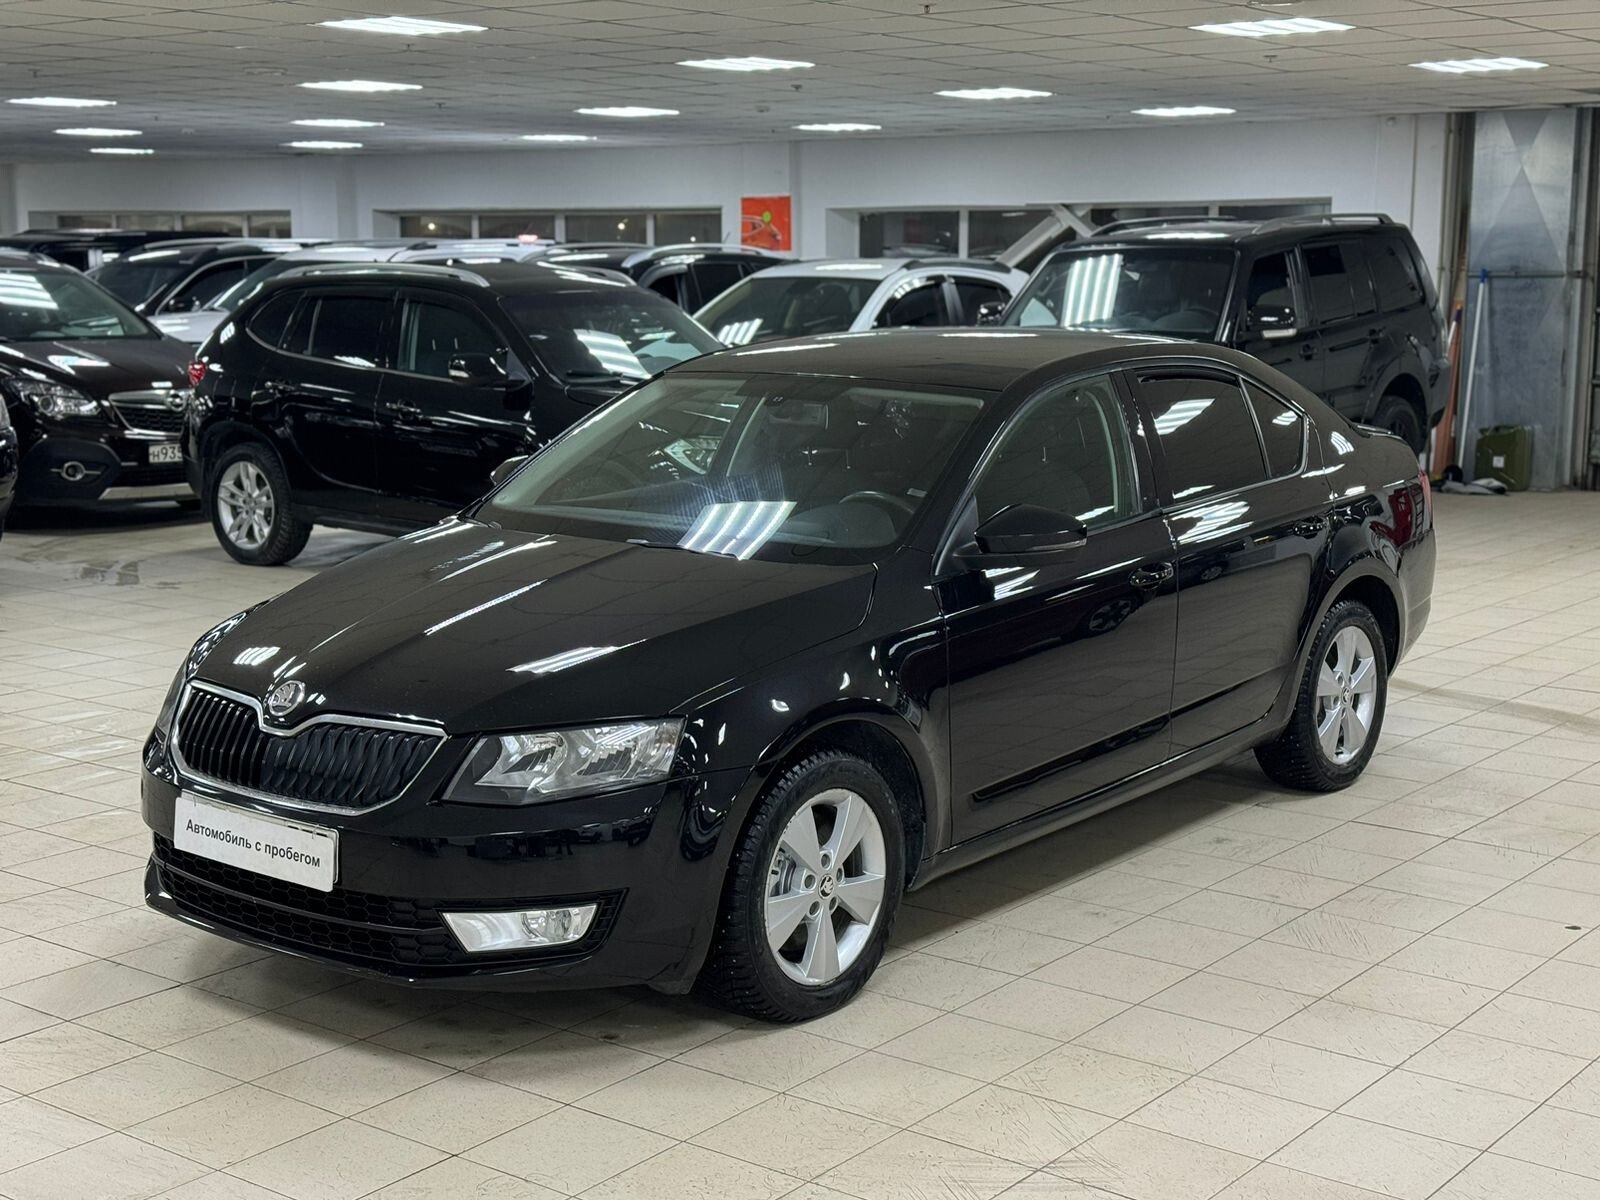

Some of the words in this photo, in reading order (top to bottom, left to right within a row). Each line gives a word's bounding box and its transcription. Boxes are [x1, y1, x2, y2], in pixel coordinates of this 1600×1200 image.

[186, 818, 252, 849] Автомобиль
[255, 841, 262, 852] с
[264, 843, 320, 867] пробегом
